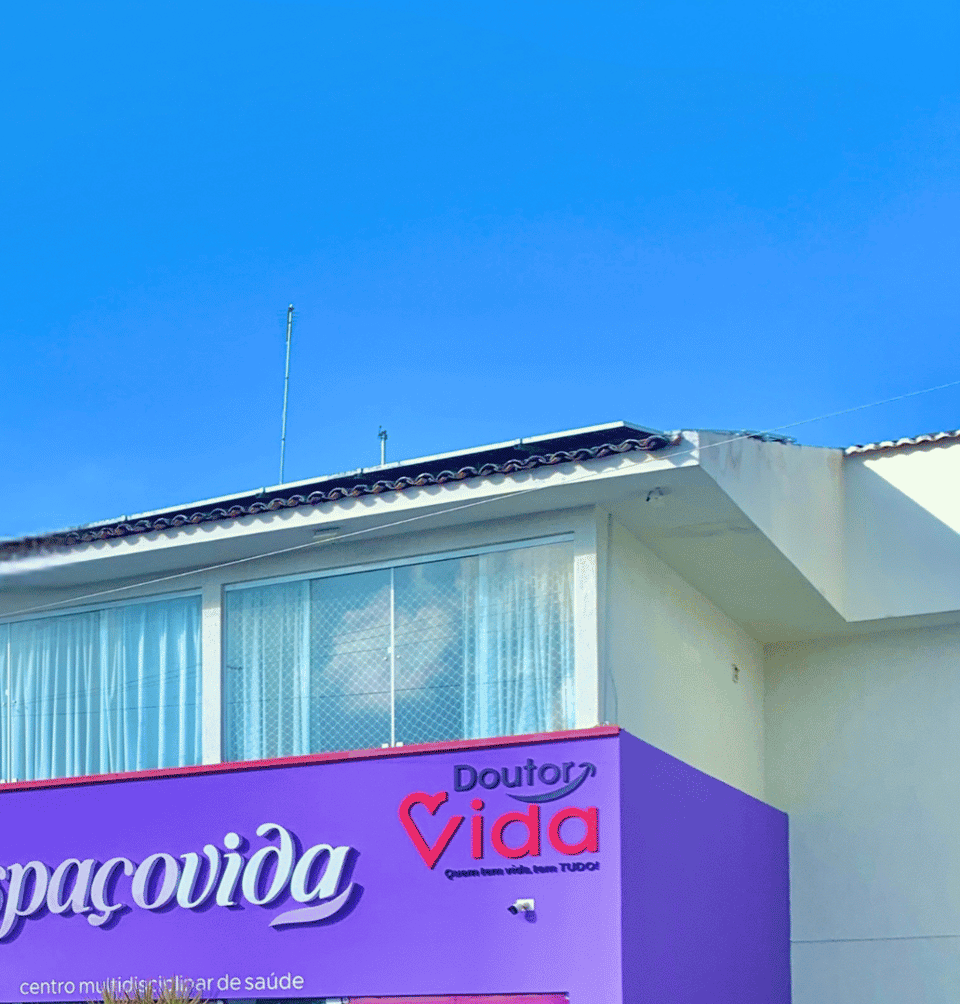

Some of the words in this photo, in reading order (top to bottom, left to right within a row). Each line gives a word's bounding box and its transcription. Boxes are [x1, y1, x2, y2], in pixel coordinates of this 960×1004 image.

[453, 758, 576, 792] Doutor
[398, 791, 600, 871] Vida
[445, 868, 480, 881] Quem
[480, 867, 505, 876] tem
[533, 865, 558, 874] tem
[559, 861, 600, 872] TUDO!
[19, 978, 76, 995] centro
[217, 973, 242, 991] de
[244, 972, 305, 990] saúde
